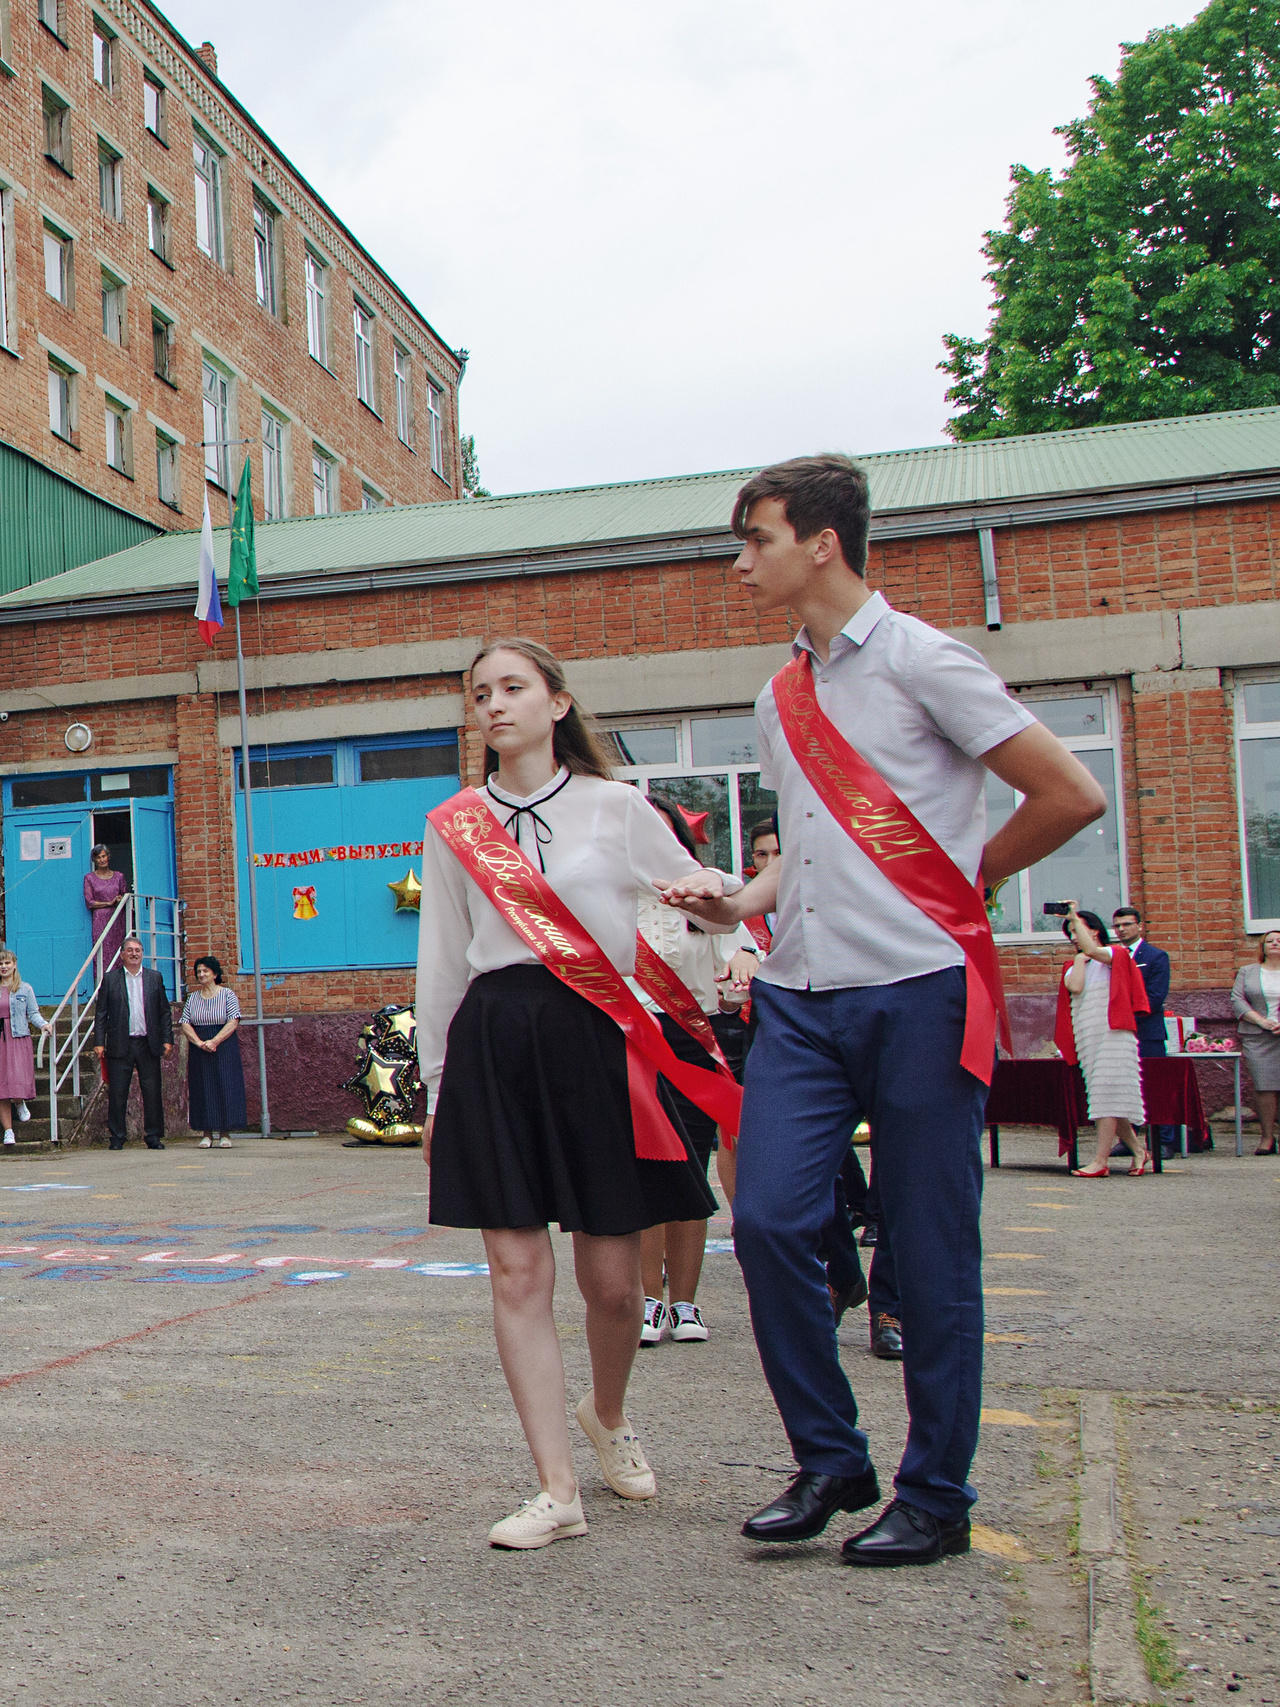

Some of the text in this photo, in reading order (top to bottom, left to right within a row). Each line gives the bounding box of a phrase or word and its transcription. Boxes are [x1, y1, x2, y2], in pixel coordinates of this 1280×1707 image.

[788, 692, 933, 862] Выпускник 2021
[473, 841, 620, 1004] Выпускник 2021
[504, 906, 537, 942] Республика
